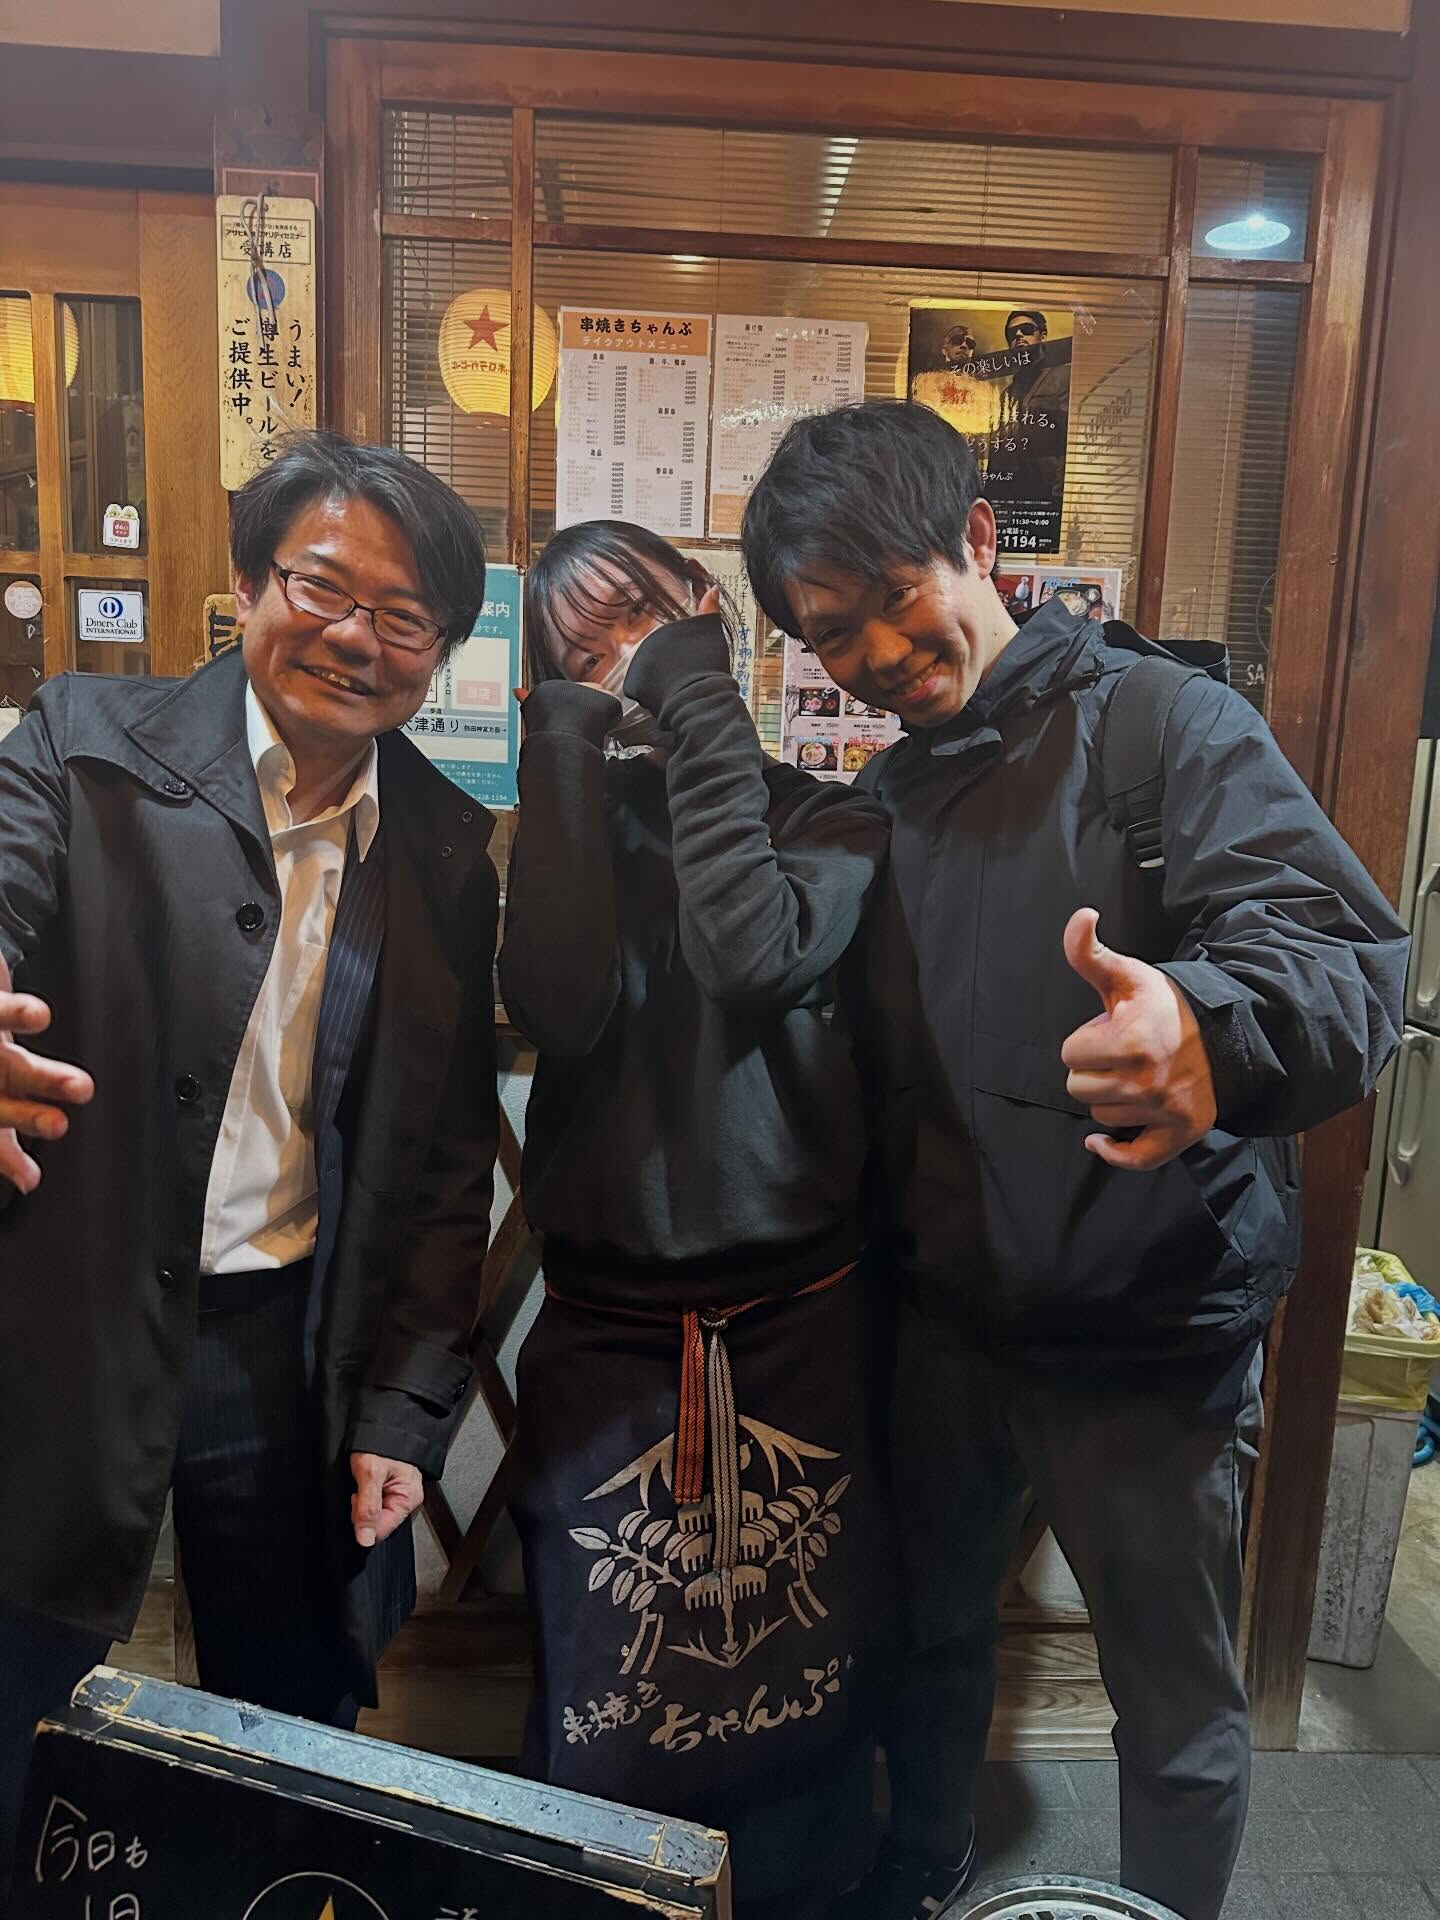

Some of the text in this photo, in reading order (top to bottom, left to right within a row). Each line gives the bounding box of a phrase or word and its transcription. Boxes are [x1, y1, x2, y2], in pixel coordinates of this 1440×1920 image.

[583, 336, 689, 350] テイクアウトメニュー
[229, 318, 254, 425] ご提供中。
[286, 319, 305, 408] うまい！
[950, 351, 1032, 377] その楽しいは
[86, 617, 138, 629] Diners Club
[86, 627, 137, 635] INTERNATIONAL
[34, 1795, 149, 1883] 今日も
